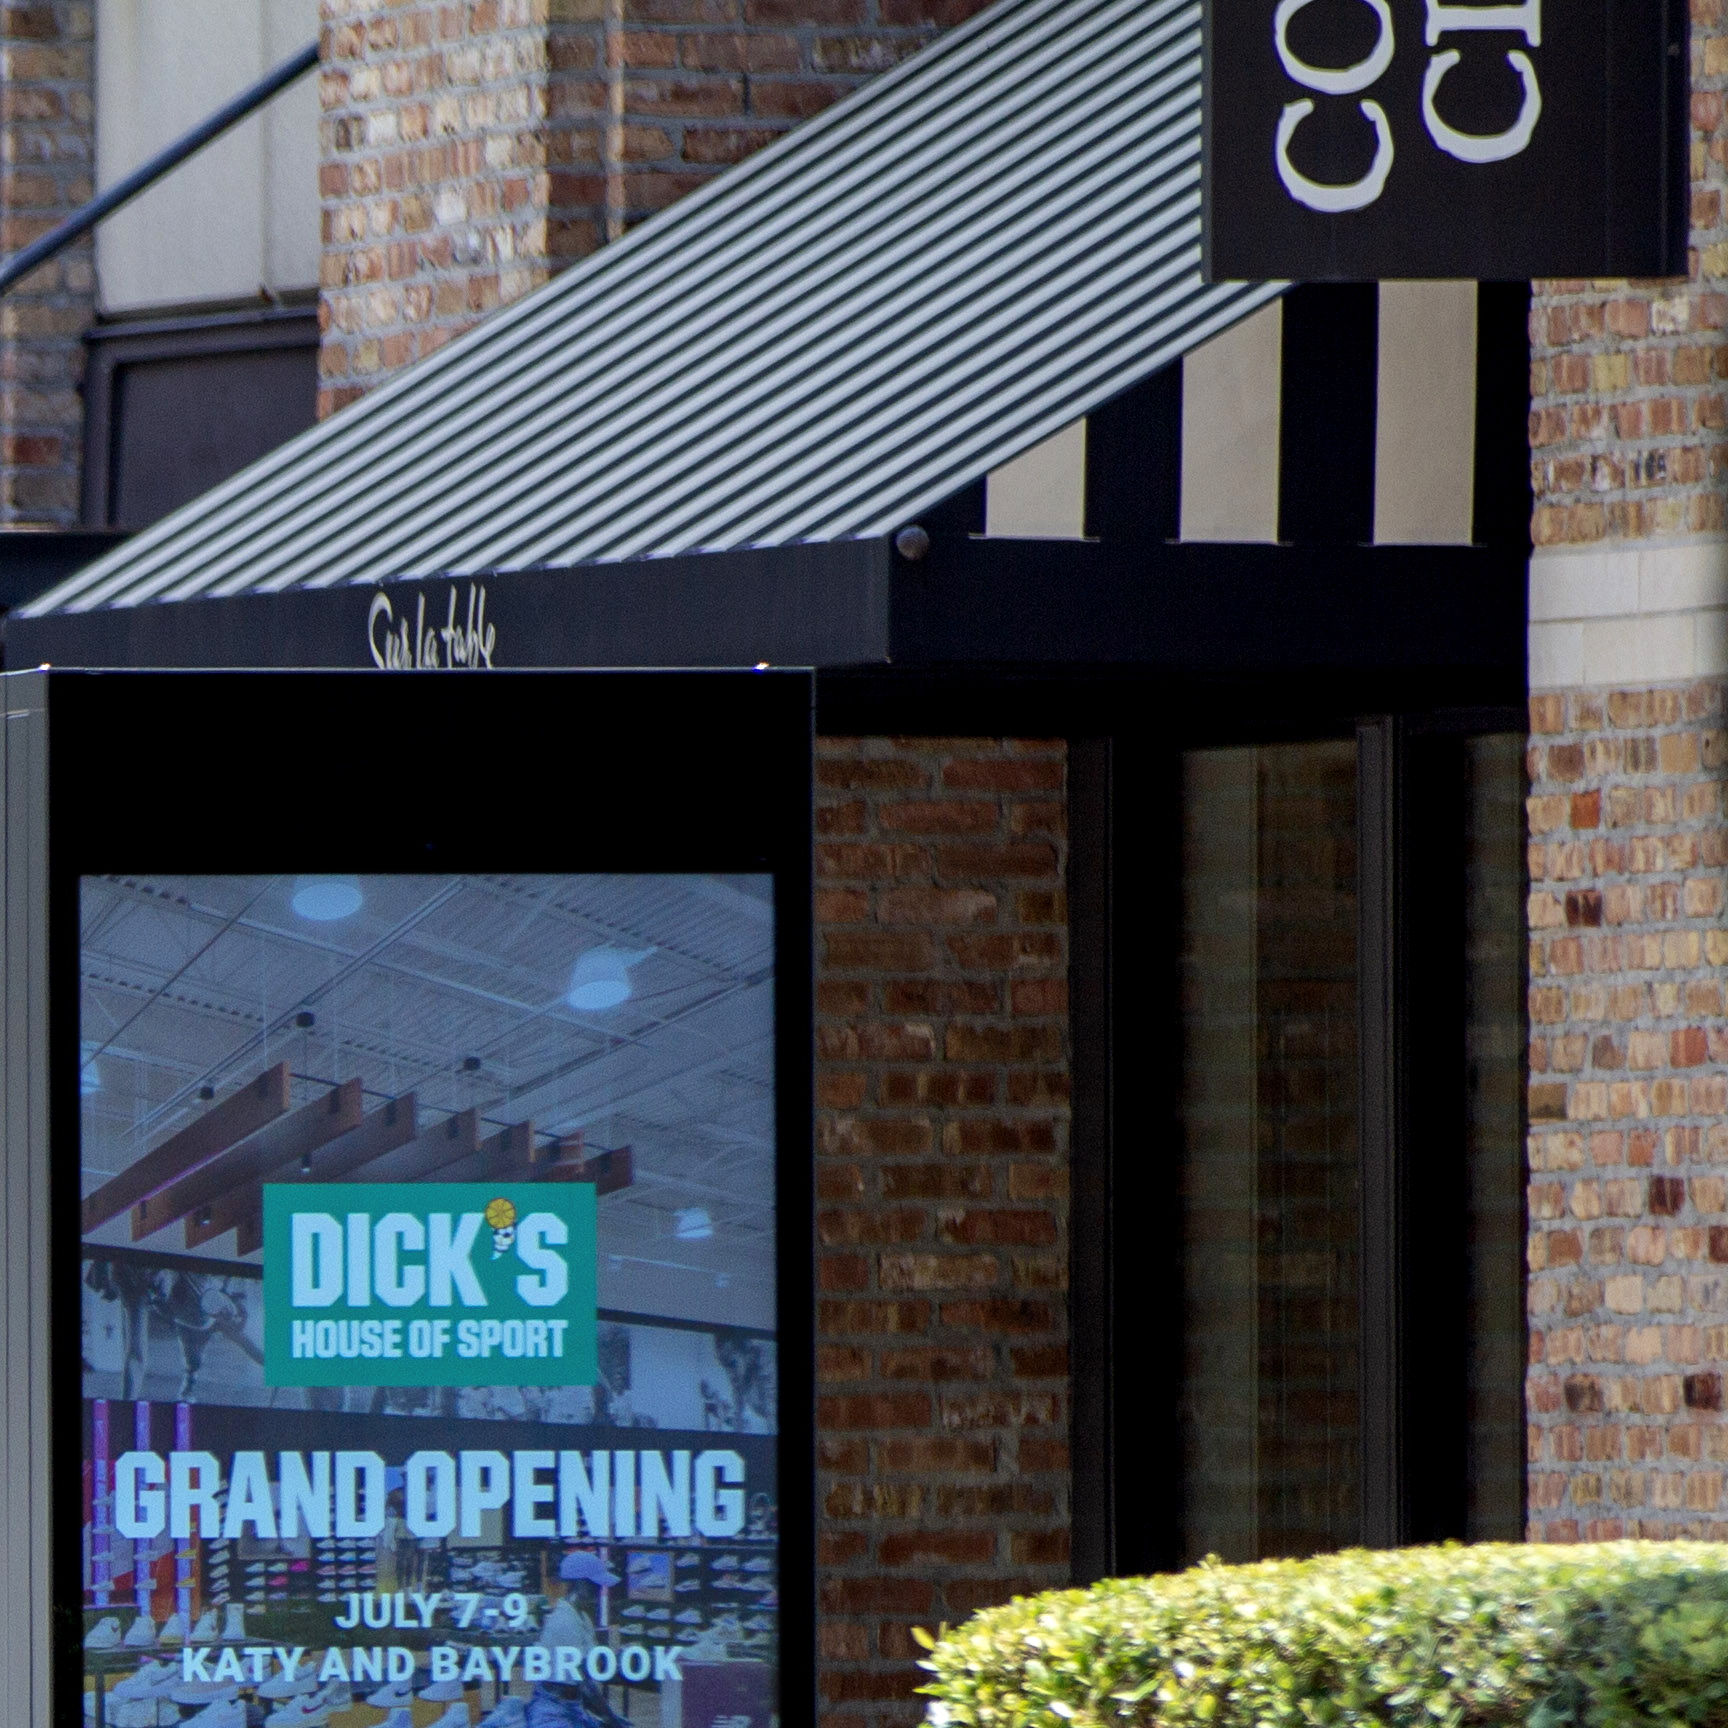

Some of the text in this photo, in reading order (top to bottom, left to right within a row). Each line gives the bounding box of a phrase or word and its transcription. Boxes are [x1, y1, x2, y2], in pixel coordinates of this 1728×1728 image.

[292, 1198, 569, 1307] DICK'S
[292, 1320, 569, 1358] HOUSE OF SPORT
[114, 1449, 746, 1539] GRAND OPENING
[334, 1593, 529, 1630] JULY 7-9
[181, 1646, 684, 1682] KATY AND BAYBROOK
